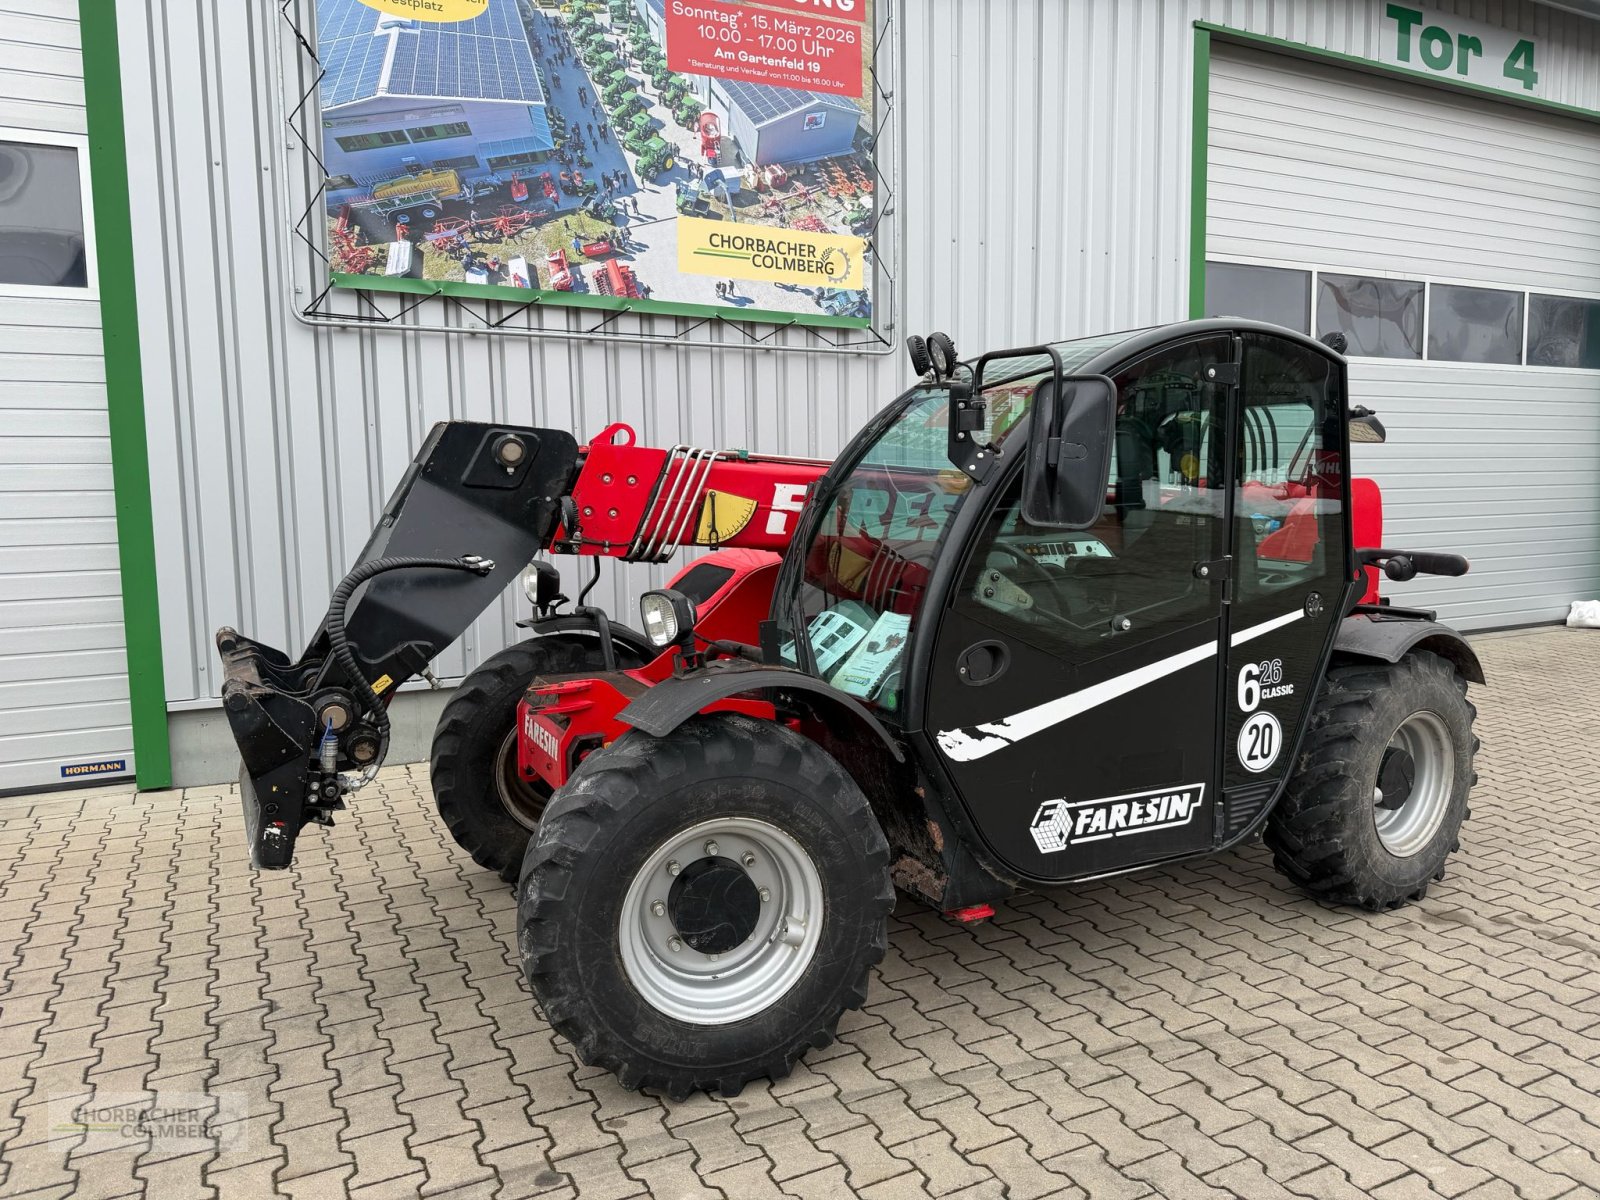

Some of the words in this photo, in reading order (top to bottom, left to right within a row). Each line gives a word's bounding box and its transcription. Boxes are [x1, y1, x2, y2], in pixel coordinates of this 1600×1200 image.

[384, 0, 443, 11] estplatz
[697, 24, 741, 44] 10.00
[758, 34, 797, 53] 17.00
[801, 39, 834, 58] Uhr
[751, 14, 771, 31] 15.
[774, 18, 812, 37] März
[815, 25, 855, 44] 2026
[714, 47, 735, 60] Am
[738, 50, 804, 71] Gartenfeld
[807, 61, 821, 73] 19
[1386, 3, 1483, 76] Tor
[1503, 39, 1539, 91] 4
[740, 66, 768, 77] Verkauf
[782, 73, 801, 82] 11.00
[801, 75, 811, 84] bis
[832, 80, 846, 88] Uhr
[709, 233, 816, 259] CHORBACHER
[752, 254, 835, 275] COLMBERG
[1261, 683, 1294, 700] CLASSIC
[524, 713, 559, 762] FARESIN
[1247, 722, 1273, 762] 20
[1074, 792, 1191, 836] FARESIN
